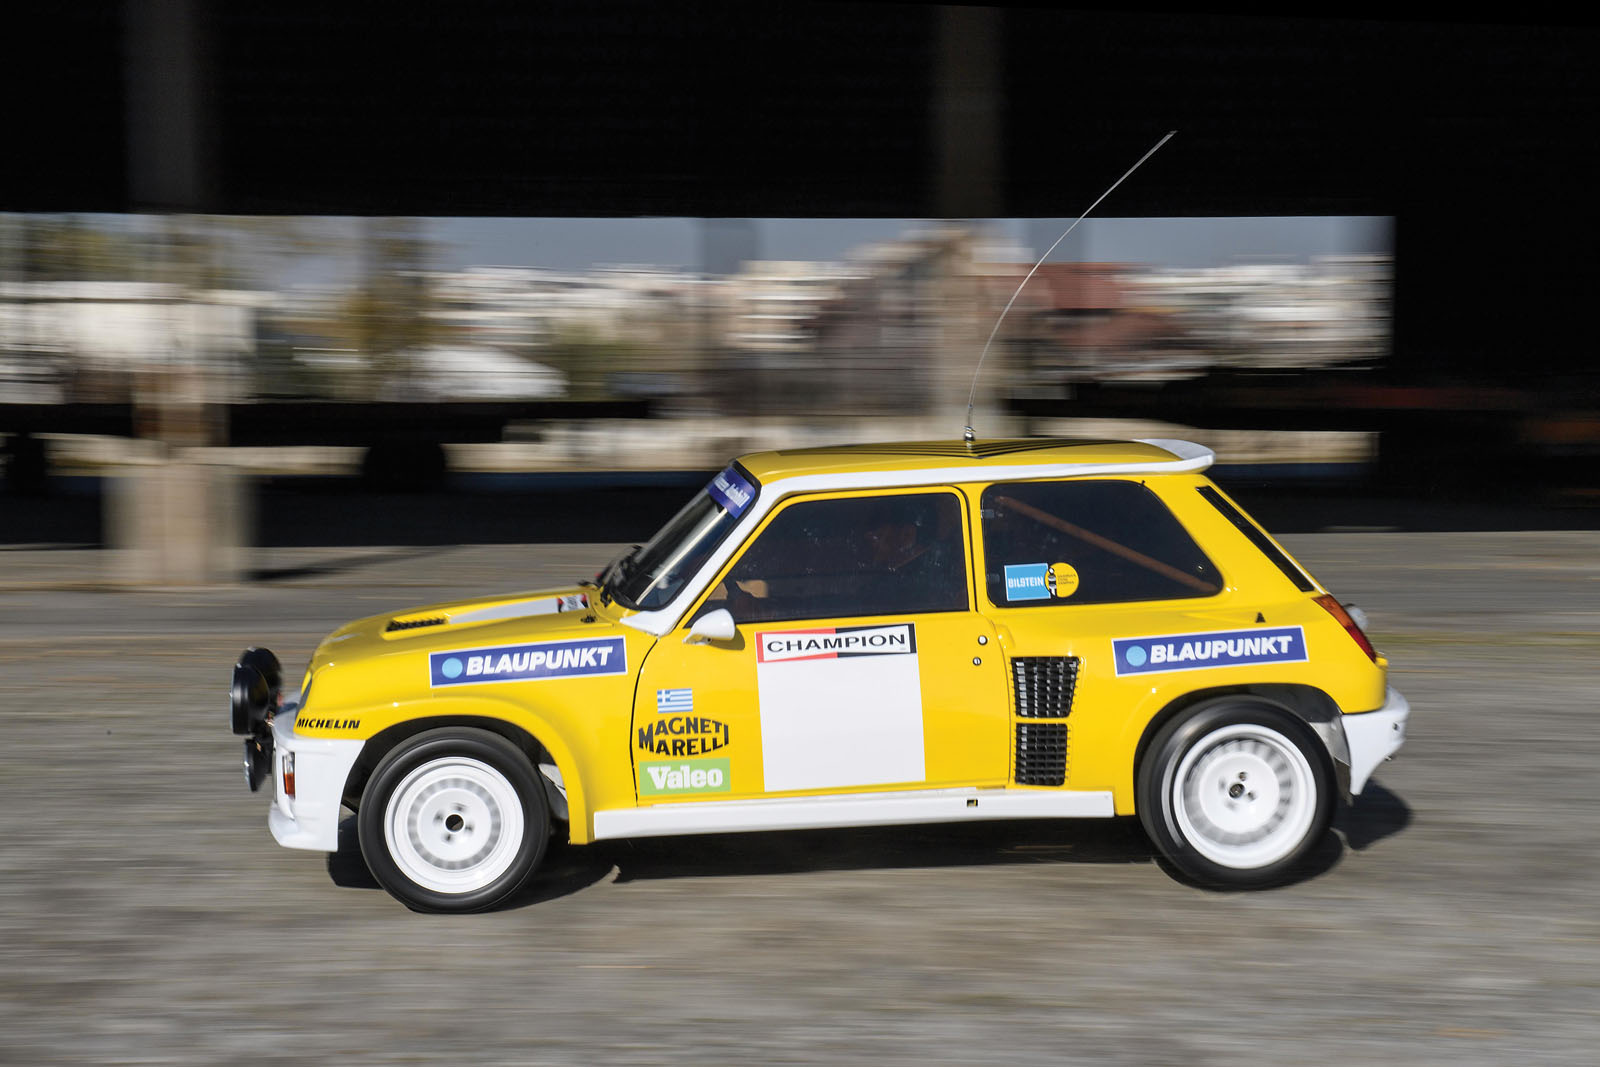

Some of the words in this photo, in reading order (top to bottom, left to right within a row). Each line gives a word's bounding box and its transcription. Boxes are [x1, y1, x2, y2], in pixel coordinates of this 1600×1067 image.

[1008, 576, 1044, 589] BILSTEIN
[767, 633, 906, 653] CHAMPION
[1150, 635, 1293, 664] BLAUPUNKT
[466, 646, 613, 676] BLAUPUNKT
[296, 718, 360, 729] MICHELIN
[638, 717, 729, 741] MAGNETI
[638, 735, 729, 756] MARELLI
[647, 764, 723, 790] Valeo
